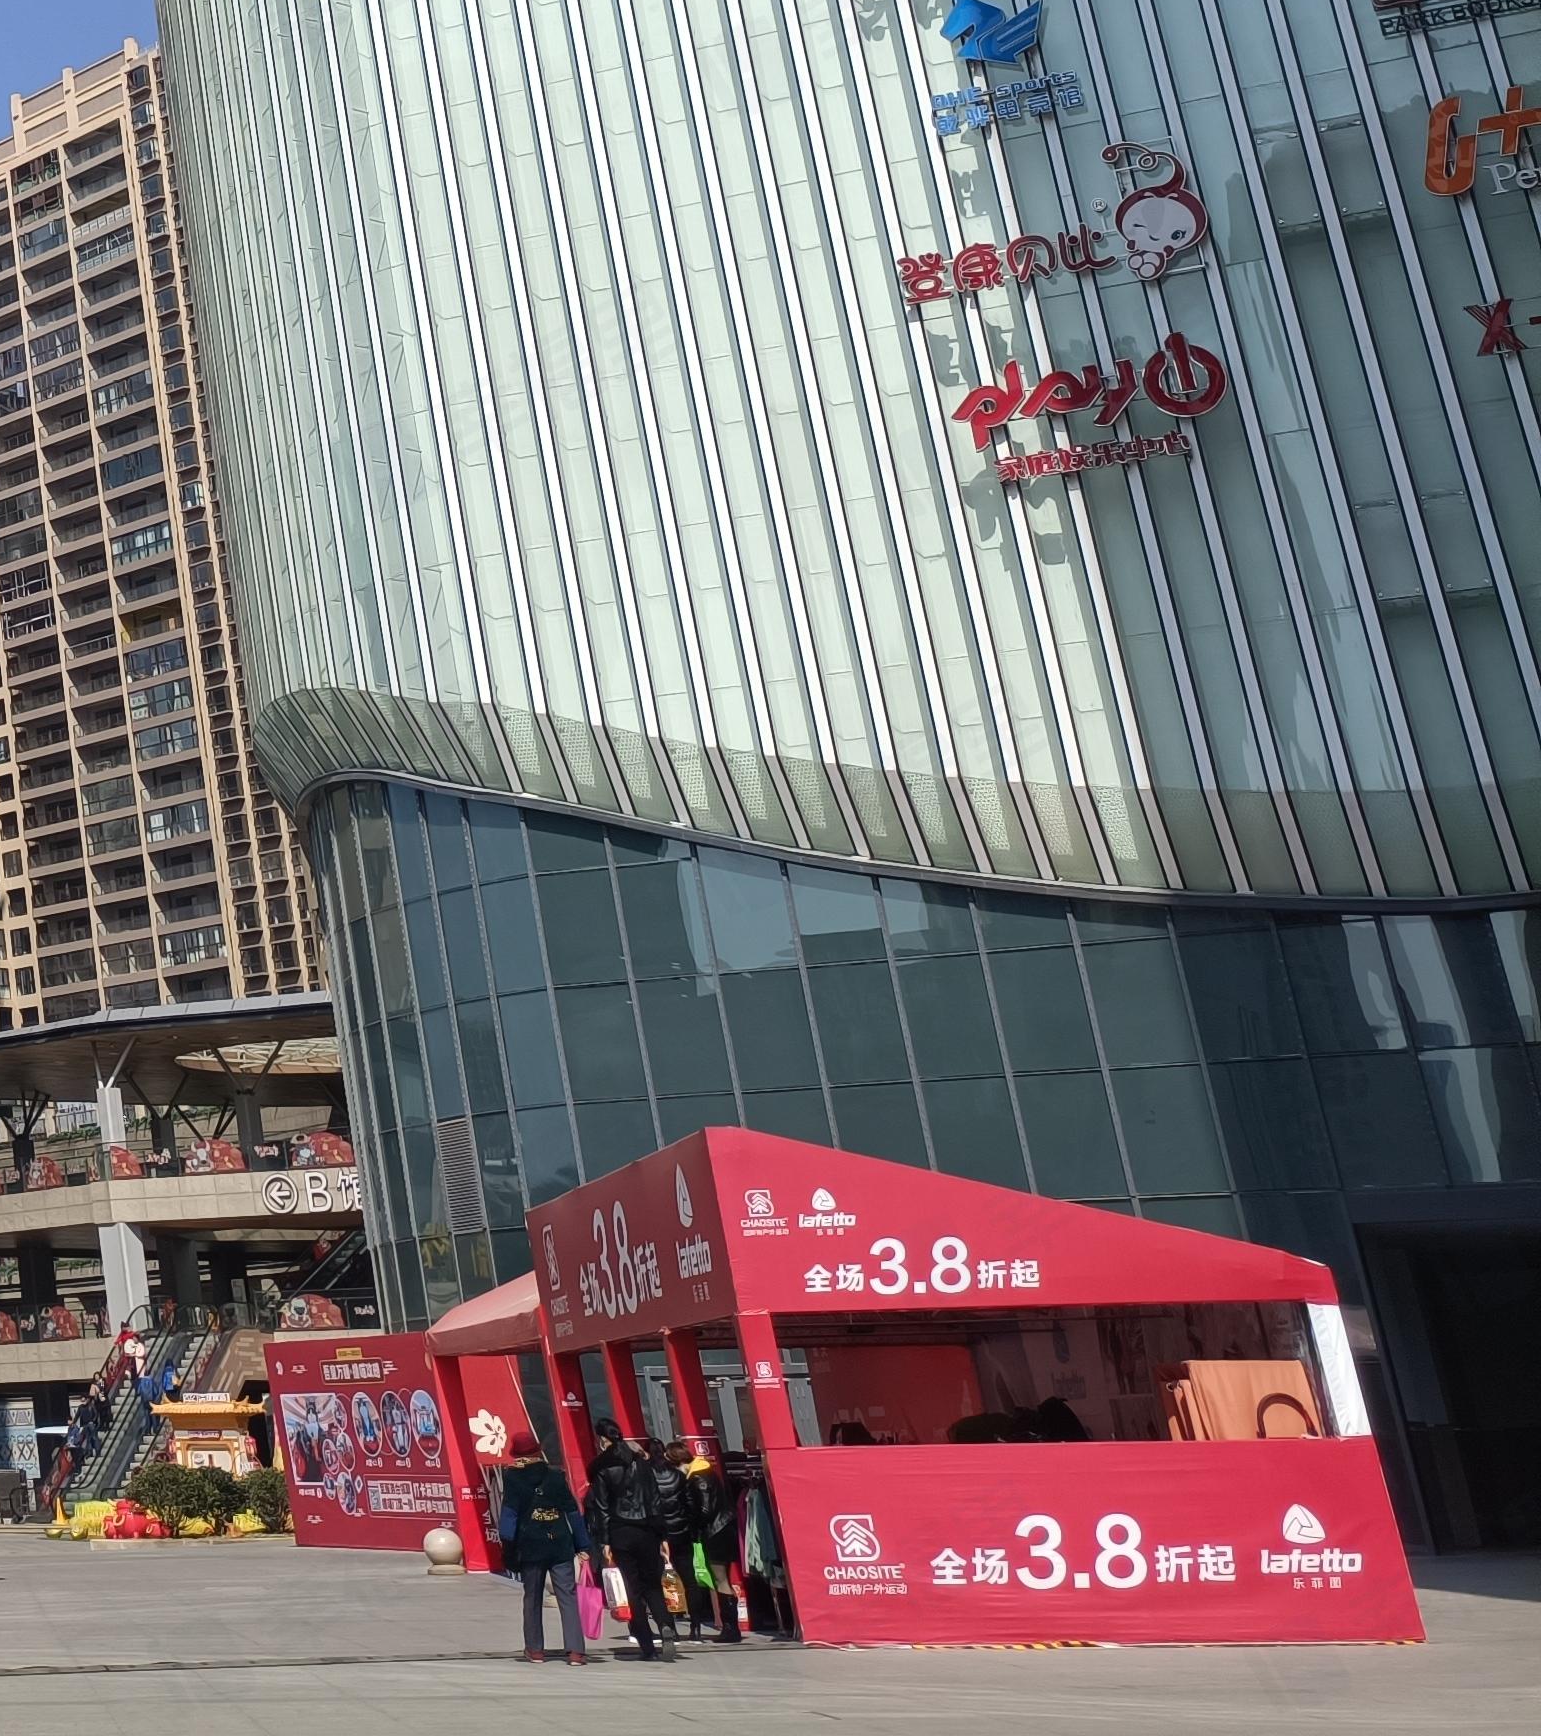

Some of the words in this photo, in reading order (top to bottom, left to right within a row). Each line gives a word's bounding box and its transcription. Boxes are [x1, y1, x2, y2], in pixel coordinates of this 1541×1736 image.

[1483, 162, 1541, 195] Pe
[994, 431, 1191, 482] 家庭娱乐中心
[579, 1200, 663, 1320] 全场3.8折起
[803, 1236, 1041, 1296] 全场3.8折起
[823, 1565, 905, 1580] CHAOSITE
[930, 1513, 1236, 1590] 全场3.8折起
[1260, 1547, 1363, 1574] lafetto
